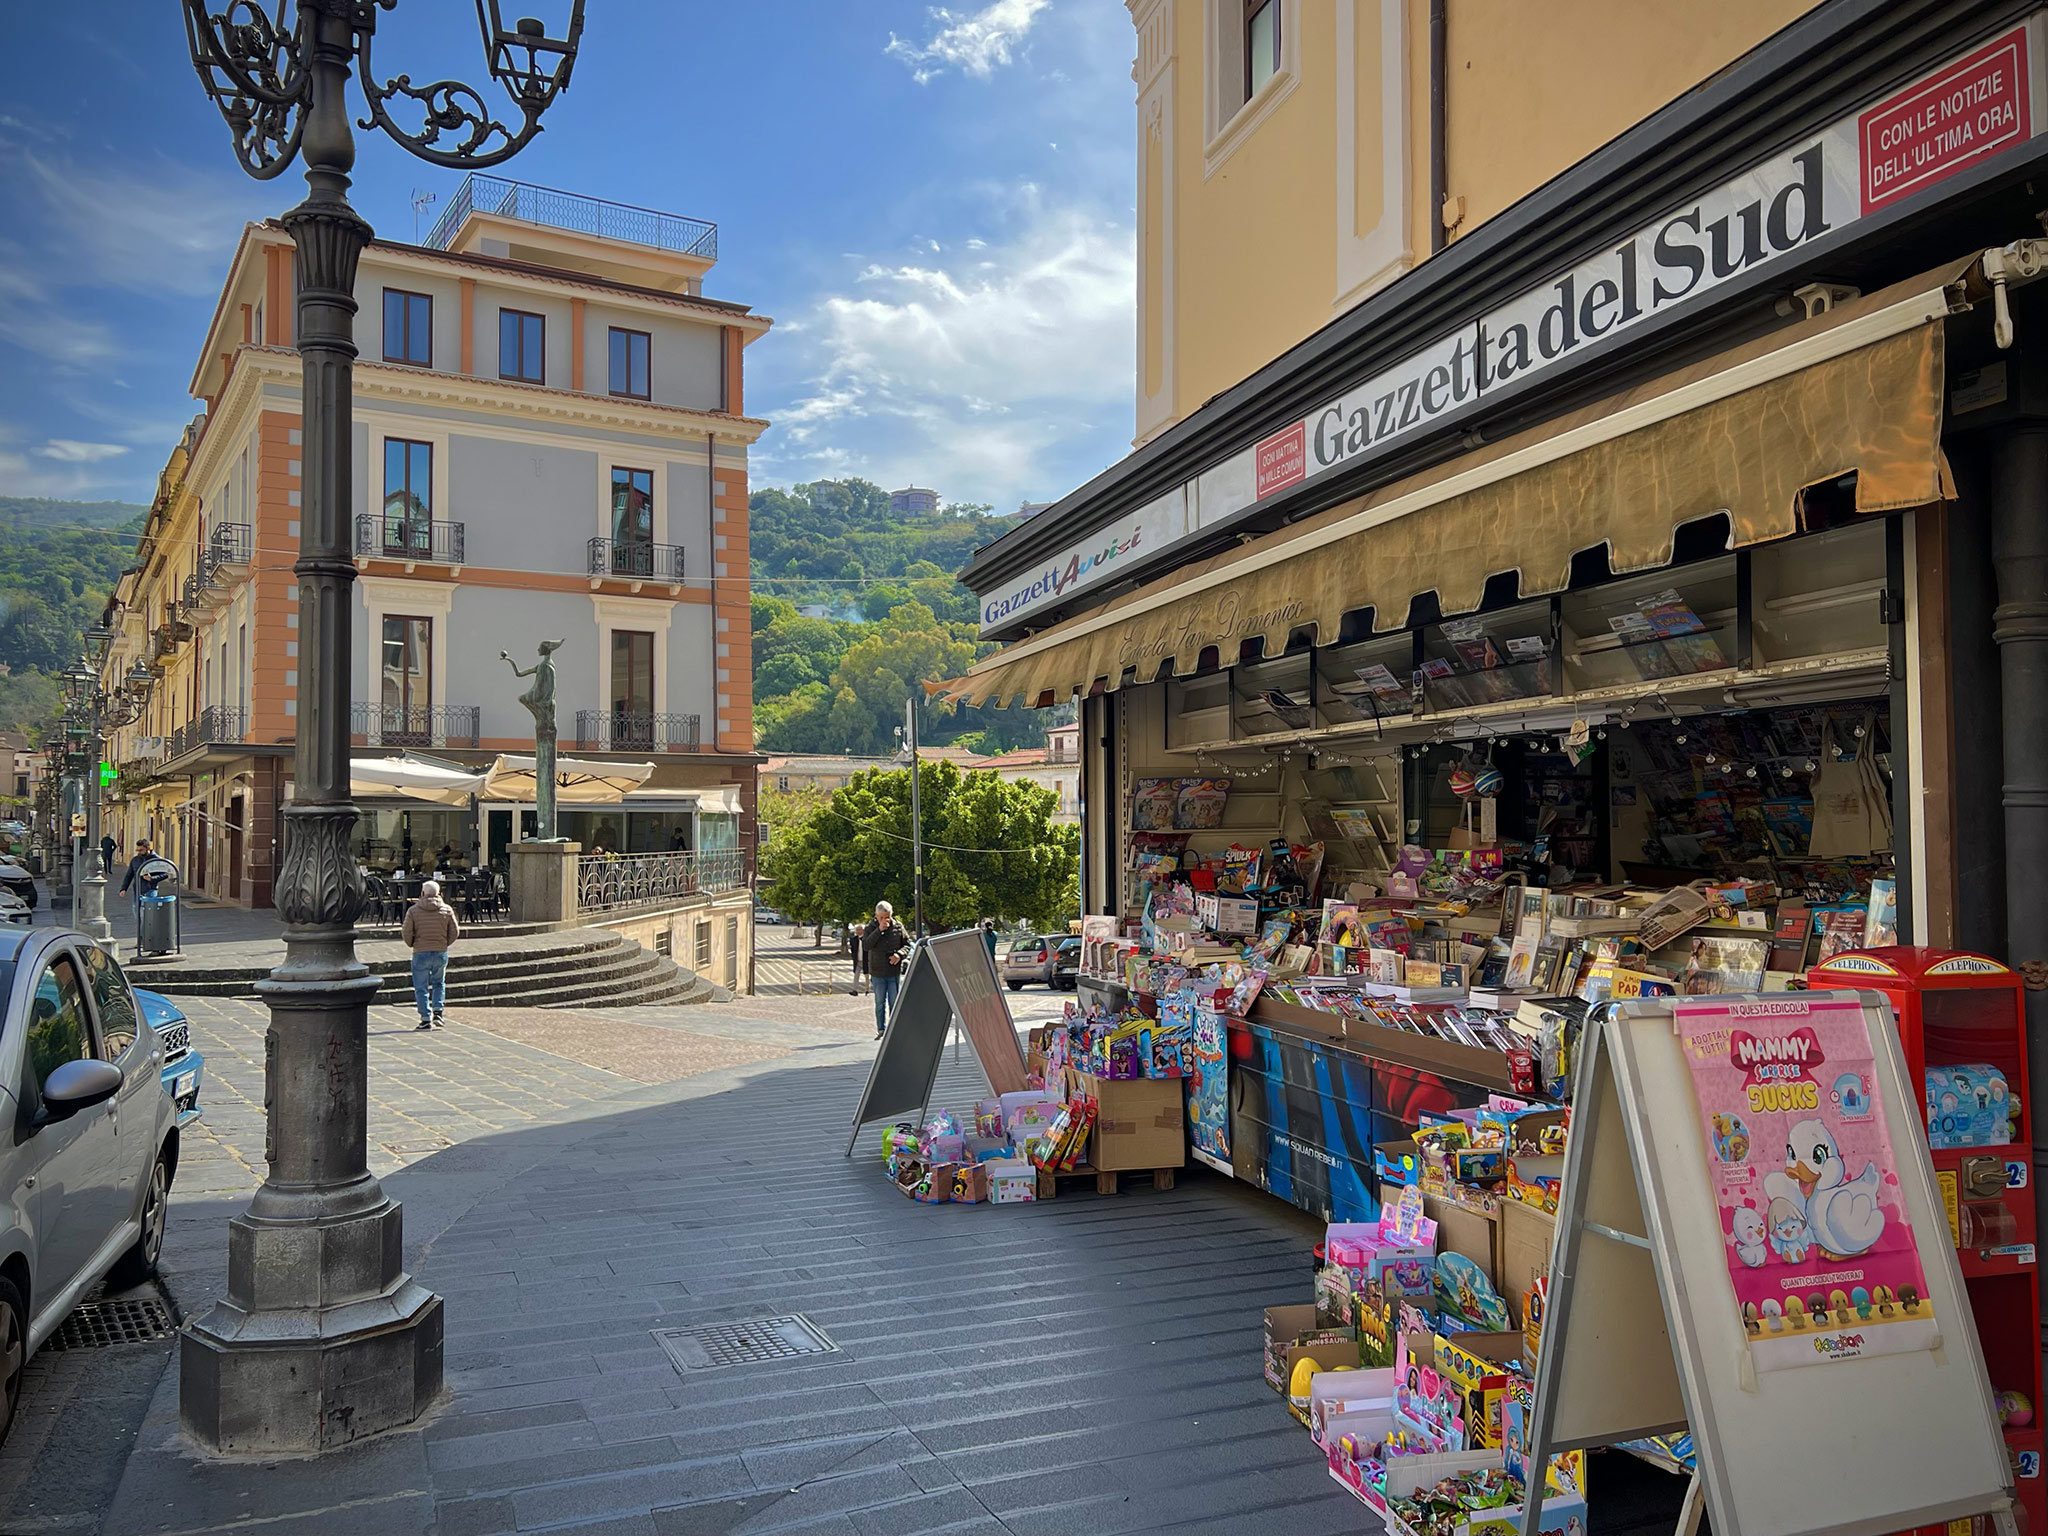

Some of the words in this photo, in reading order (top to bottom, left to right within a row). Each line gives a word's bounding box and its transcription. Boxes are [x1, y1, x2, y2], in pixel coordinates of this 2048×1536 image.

[1880, 111, 1914, 151] CON
[1917, 104, 1937, 134] LE
[1940, 69, 2004, 121] NOTIZIE
[1873, 123, 1974, 187] DELL'ULTIMA
[1977, 100, 2015, 135] ORA
[1262, 451, 1276, 467] OGNI
[1275, 439, 1298, 460] MATTINA
[1260, 473, 1266, 486] IN
[1265, 465, 1281, 483] MILLE
[1280, 455, 1303, 476] COMUNI
[1119, 621, 1169, 665] Edicola
[1174, 603, 1207, 650] San
[1216, 590, 1304, 641] Domenico
[1832, 958, 1882, 971] TELEPHONE
[1940, 959, 1993, 972] TELEPHONE
[1730, 1006, 1739, 1015] IN
[1740, 1004, 1769, 1016] QUESTA
[1770, 1002, 1809, 1014] EDICOLA!
[1691, 1030, 1729, 1046] ADOTTALI
[1738, 1036, 1811, 1065] MAMMY
[1747, 1081, 1819, 1113] DUCKS
[1781, 1276, 1806, 1289] QUANTI
[1806, 1274, 1831, 1286] CUCCIOLI
[1831, 1270, 1864, 1283] TROVERAI?
[1361, 1309, 1387, 1344] DINO
